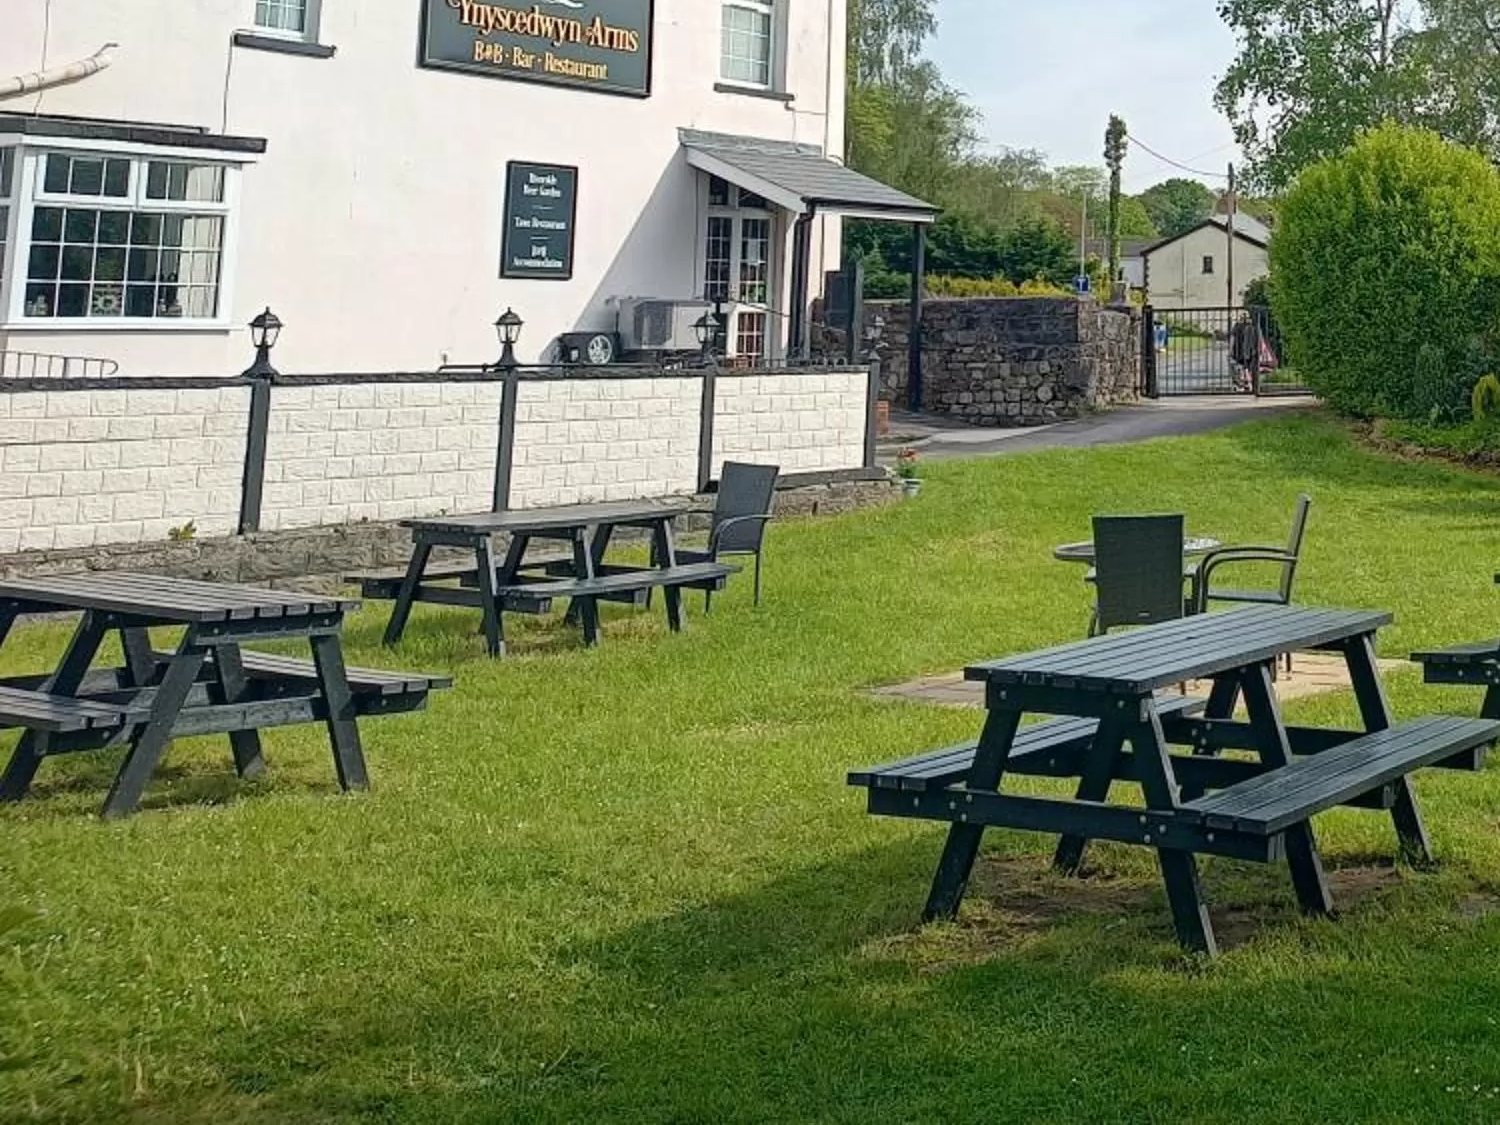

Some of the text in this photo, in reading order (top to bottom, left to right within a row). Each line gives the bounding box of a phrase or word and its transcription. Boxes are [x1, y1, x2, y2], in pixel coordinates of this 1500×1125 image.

[585, 15, 640, 52] Arms
[512, 46, 535, 69] Bar
[544, 51, 608, 79] Restaurant
